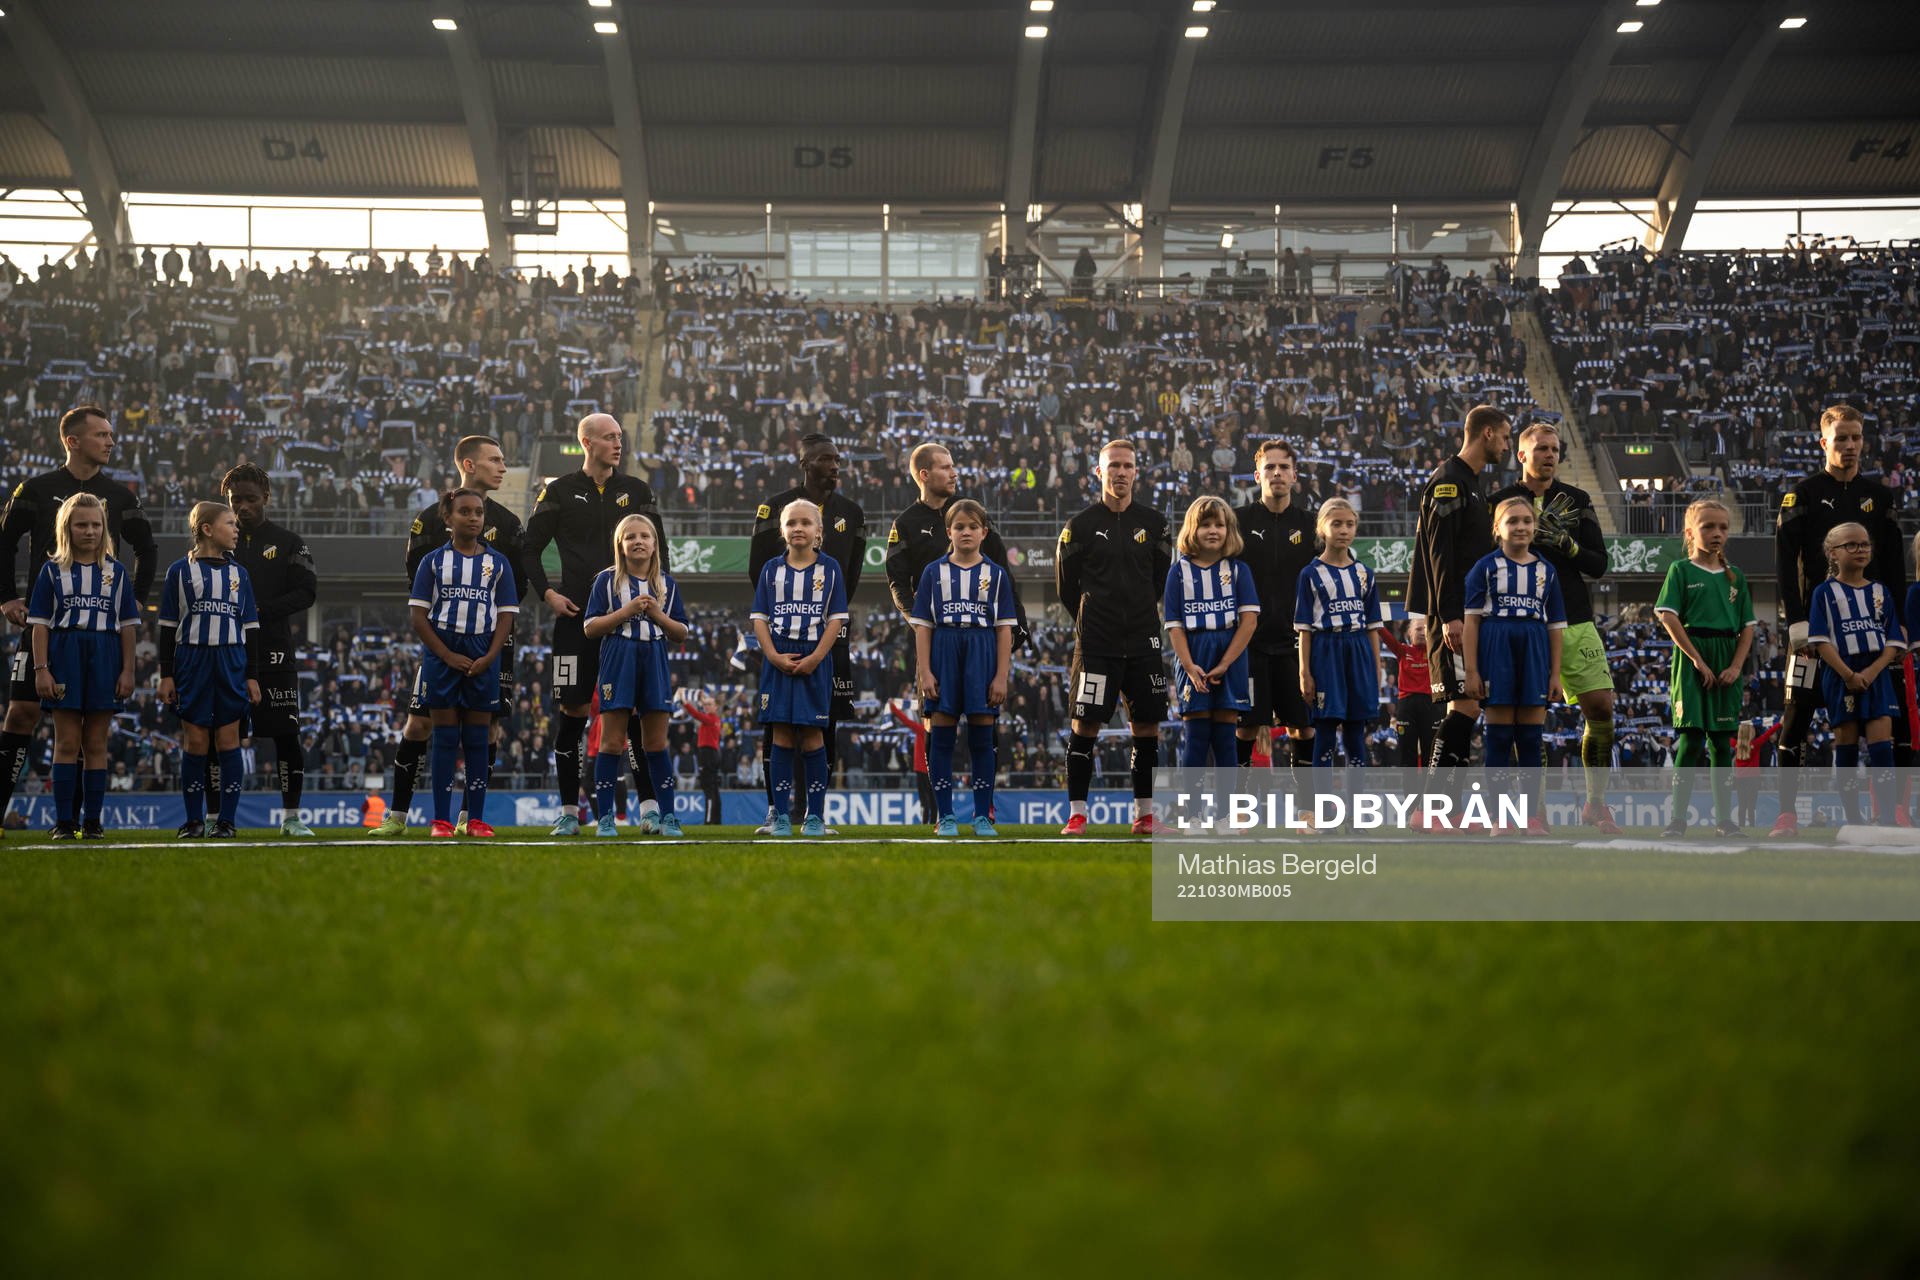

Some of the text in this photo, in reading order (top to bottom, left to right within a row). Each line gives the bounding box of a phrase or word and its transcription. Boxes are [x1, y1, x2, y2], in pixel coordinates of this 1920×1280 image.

[794, 147, 853, 169] D5
[1319, 147, 1374, 170] F5
[1028, 549, 1043, 558] Got
[1028, 557, 1054, 567] Event
[441, 587, 488, 602] SERNEKE
[63, 596, 110, 610] SERNEKE
[192, 601, 238, 616] SERNEKE
[774, 603, 822, 615] SERNEKE
[943, 602, 987, 615] SERNEKE
[1184, 598, 1235, 614] SERNEKE
[1149, 637, 1160, 649] 18
[270, 652, 285, 664] 37
[268, 688, 297, 700] Varis
[1076, 704, 1085, 717] 18
[1020, 802, 1065, 824] IFK
